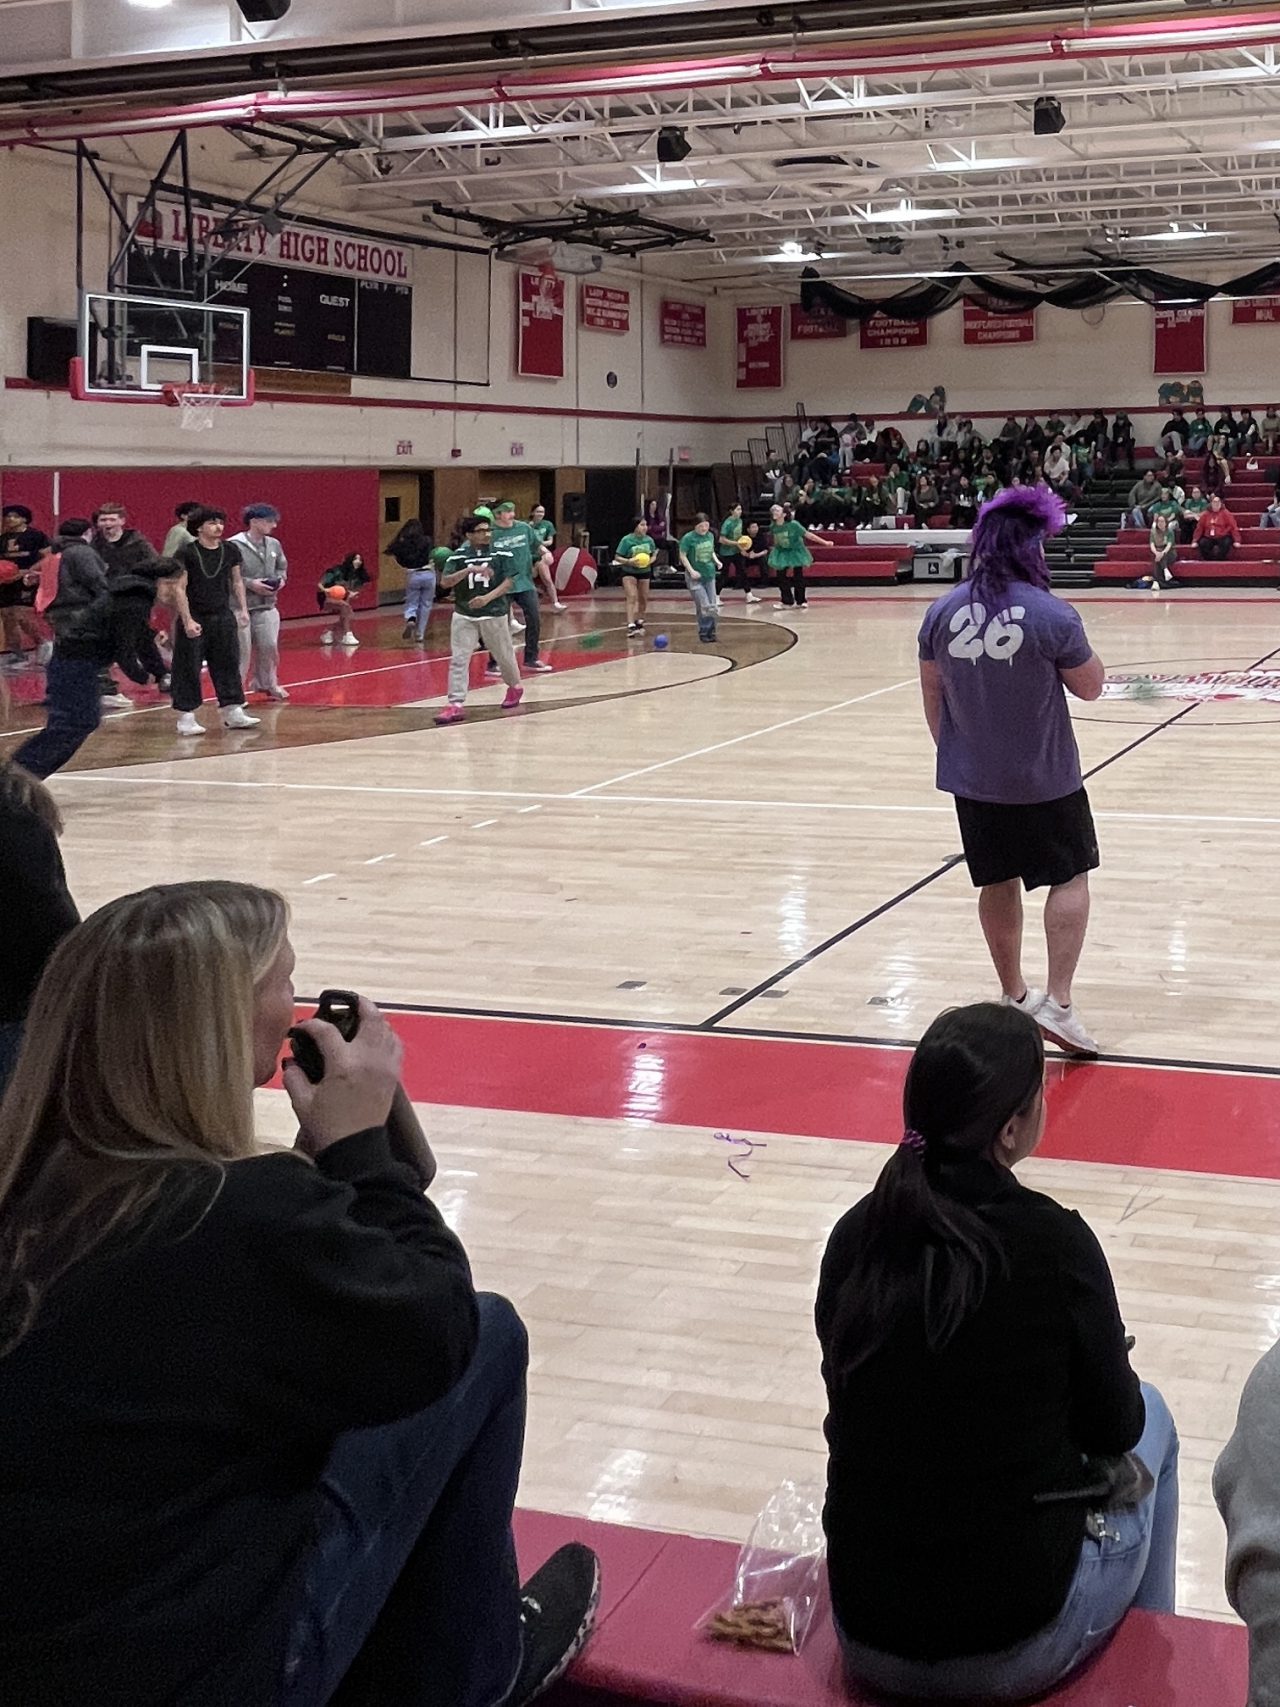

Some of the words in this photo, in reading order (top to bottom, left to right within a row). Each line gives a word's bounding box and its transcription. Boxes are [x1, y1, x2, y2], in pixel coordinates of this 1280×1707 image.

[172, 208, 267, 255] LBETY
[279, 231, 329, 266] HIGH
[334, 239, 408, 279] SCHOOL
[214, 278, 249, 295] HOME
[319, 294, 350, 308] GUEST
[868, 319, 918, 327] FOOTBALL
[867, 327, 920, 337] CHAMPIONS
[948, 602, 1026, 667] 26
